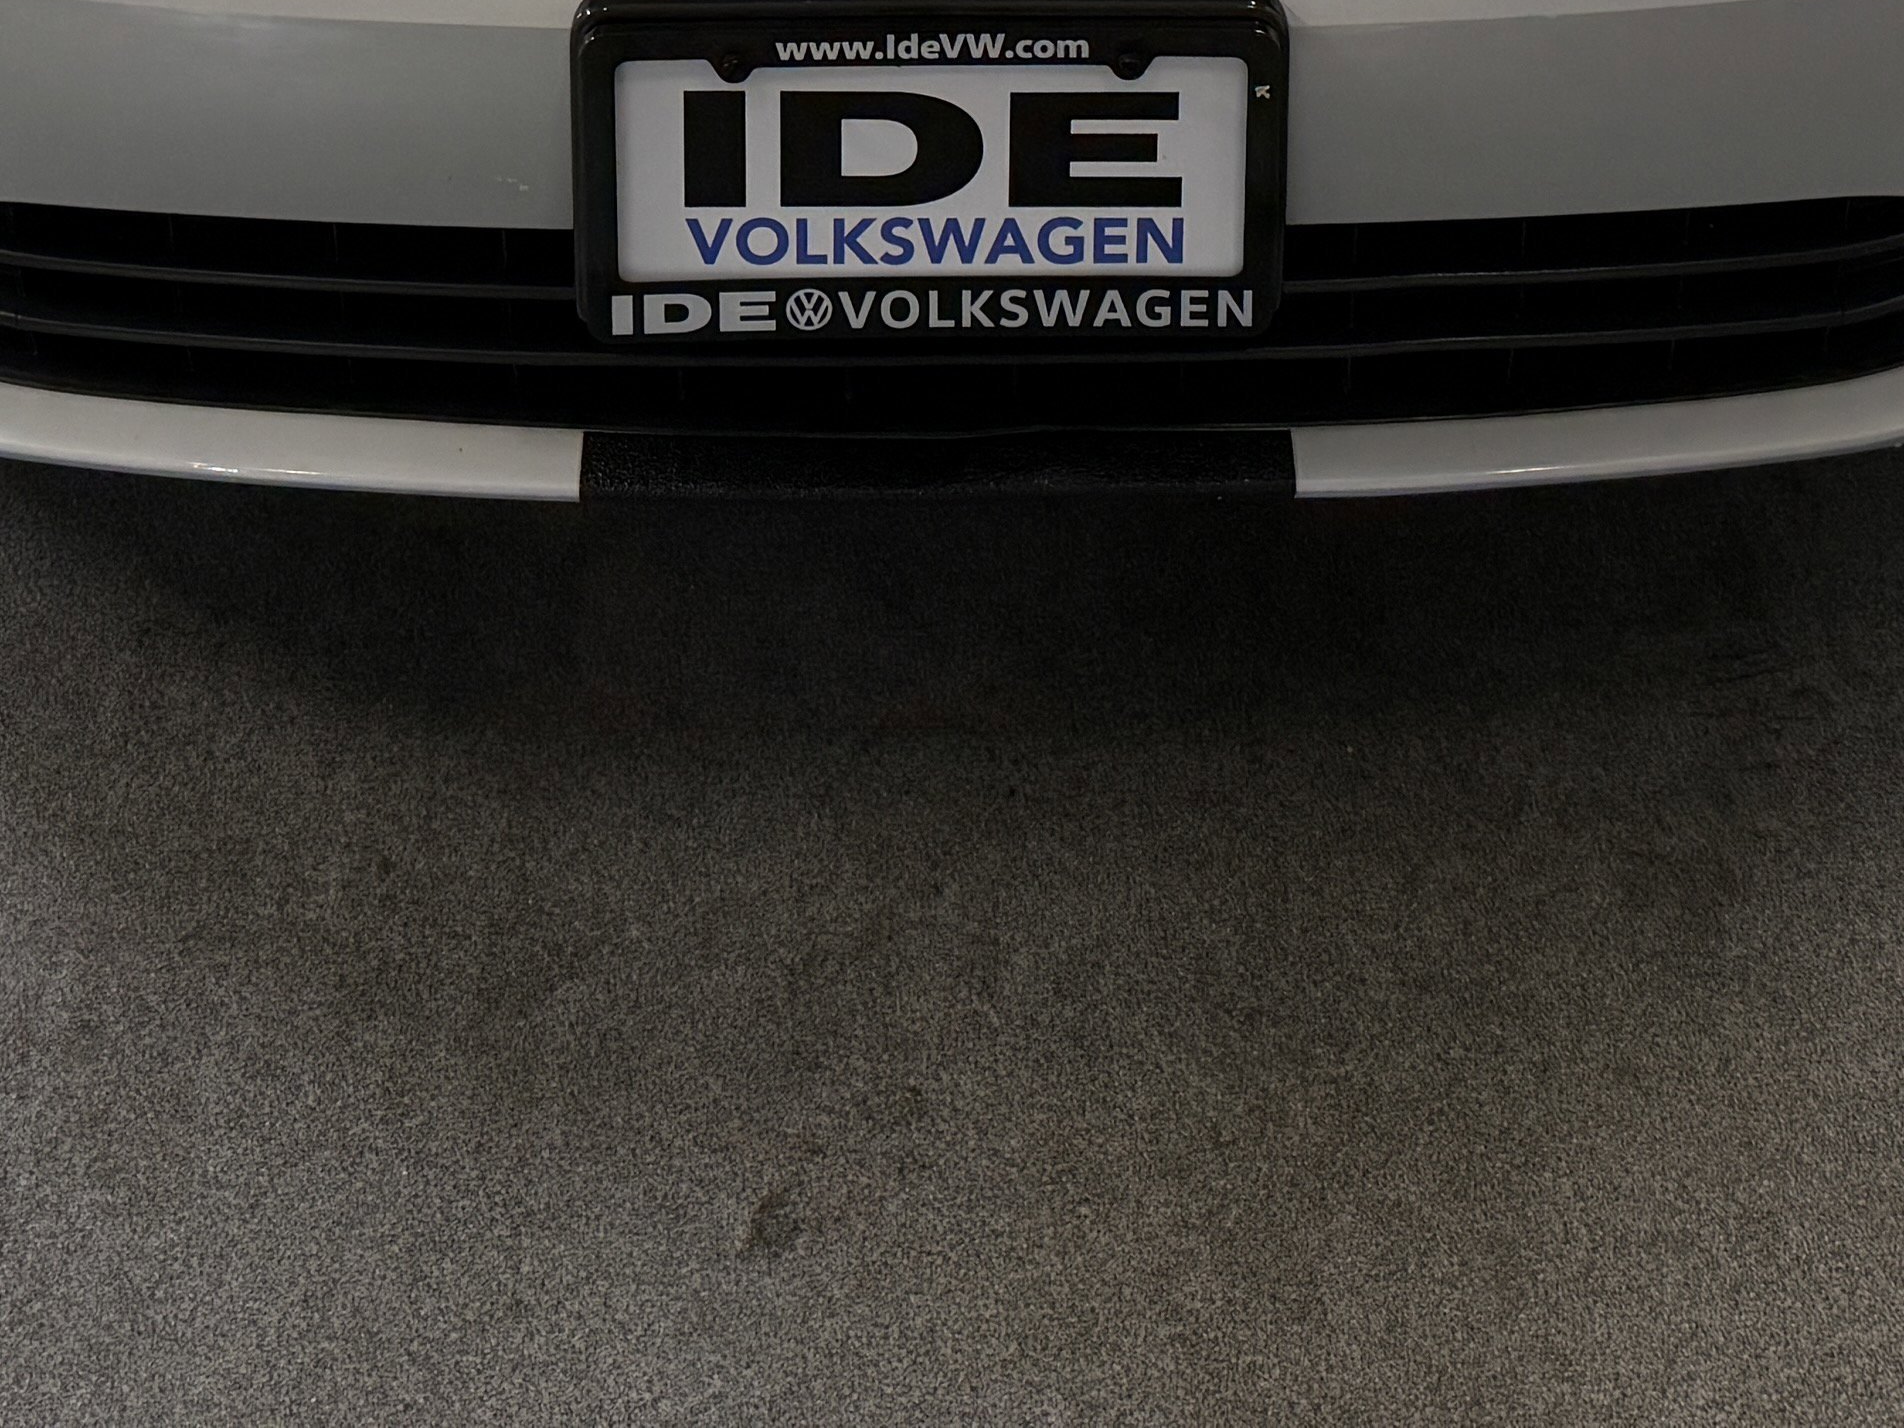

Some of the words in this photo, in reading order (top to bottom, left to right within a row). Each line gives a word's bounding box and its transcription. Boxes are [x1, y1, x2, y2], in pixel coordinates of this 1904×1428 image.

[776, 33, 1090, 61] www.IdeVW.com
[683, 90, 1183, 208] IDE
[684, 216, 1185, 266] VOLKSWAGEN
[611, 291, 777, 336] IDE
[837, 289, 1253, 329] VOLKSWAGEN
